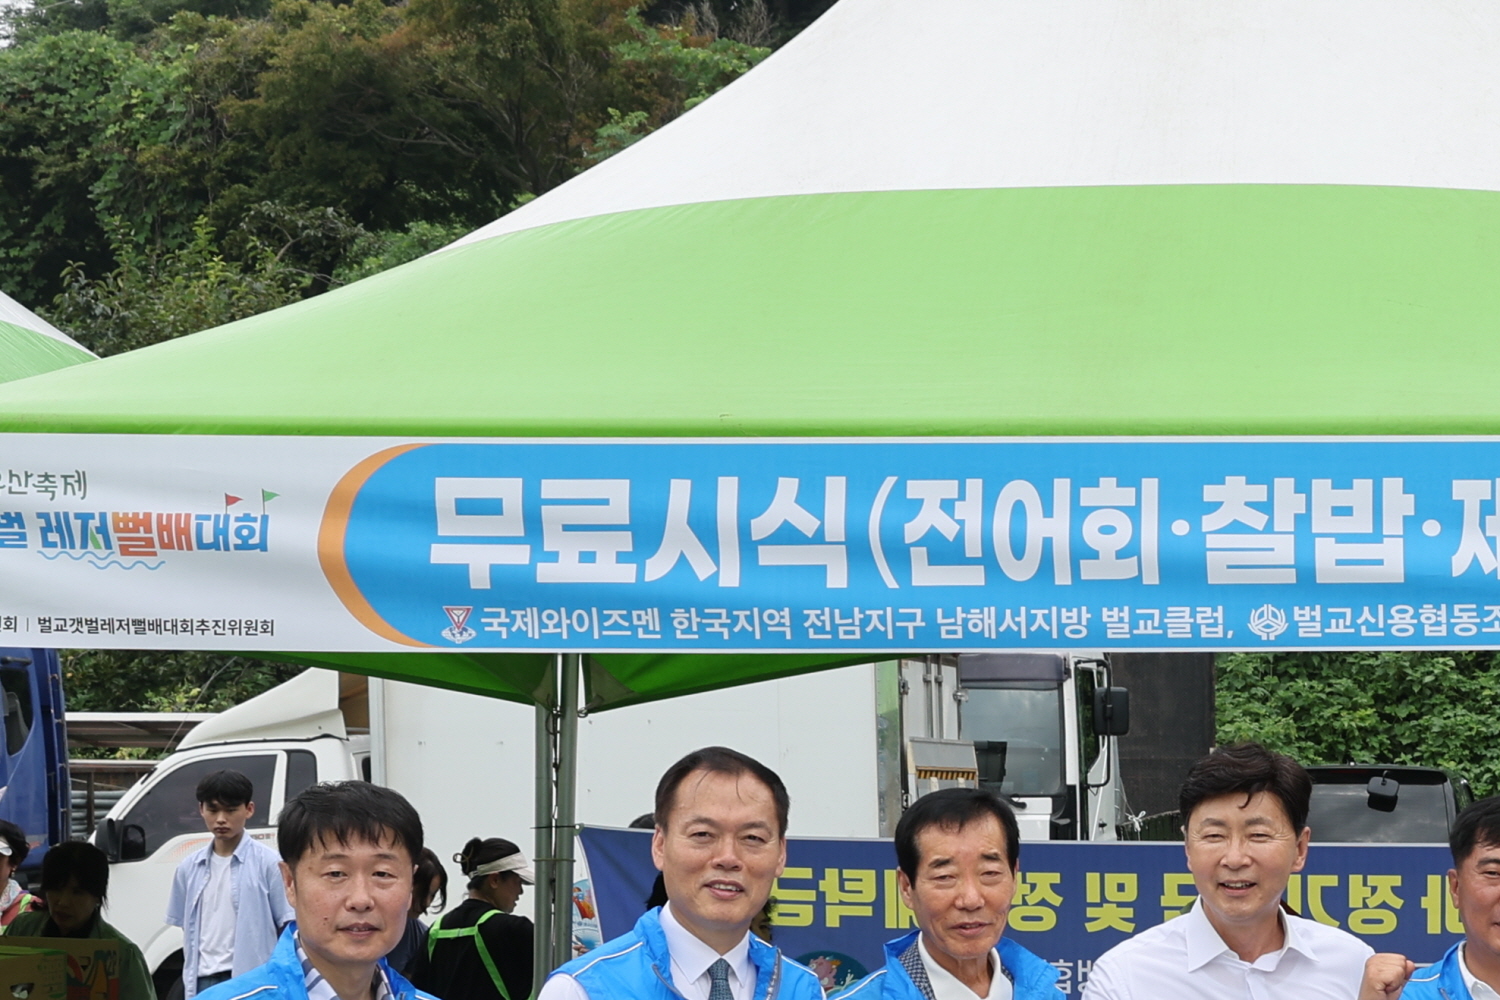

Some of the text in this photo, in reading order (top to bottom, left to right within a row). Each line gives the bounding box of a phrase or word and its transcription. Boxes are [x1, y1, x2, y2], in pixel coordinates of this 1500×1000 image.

[0, 469, 88, 501] 산축제
[36, 511, 269, 557] 레저뻘배대회
[0, 616, 275, 637] 회 벌교갯벌레저뻘배대회추진위원회
[481, 607, 661, 640] 국제와이즈멘
[671, 607, 791, 640] 한국지역
[803, 606, 926, 640] 전남지구
[937, 606, 1088, 640] 남해서지방
[1101, 605, 1234, 640] 벌교클럽,
